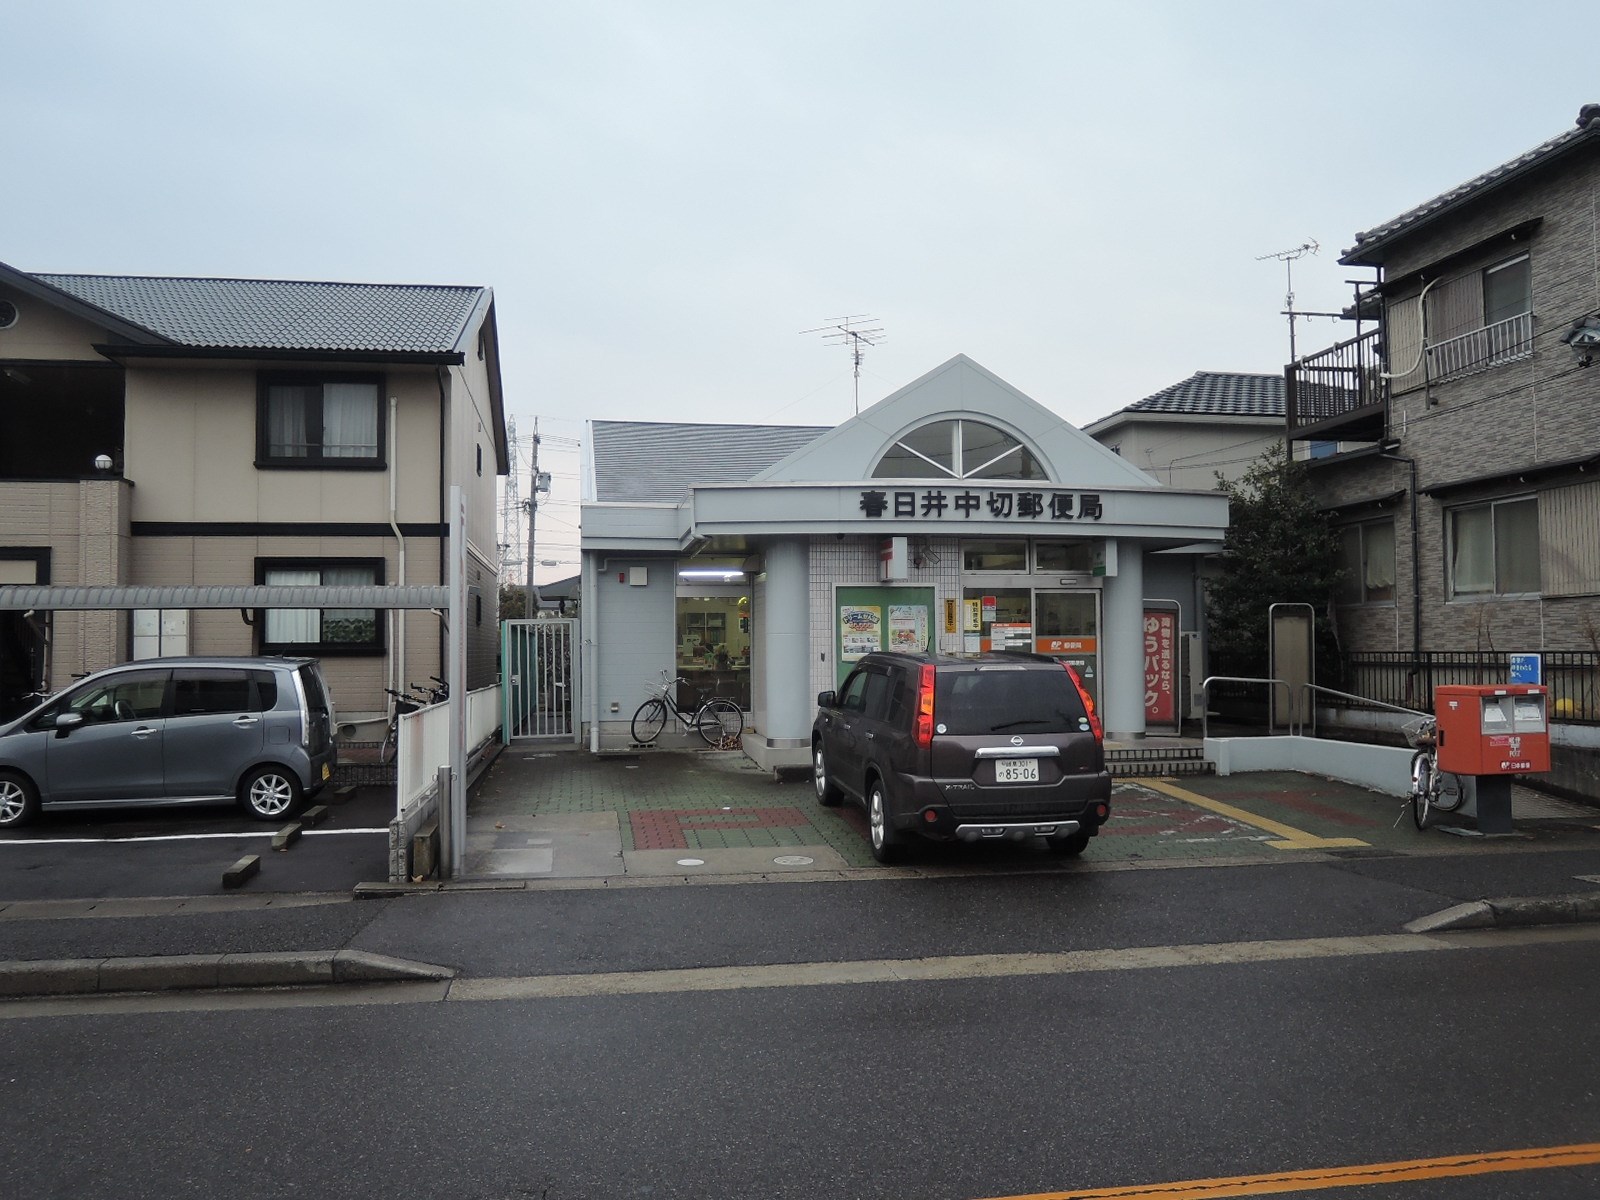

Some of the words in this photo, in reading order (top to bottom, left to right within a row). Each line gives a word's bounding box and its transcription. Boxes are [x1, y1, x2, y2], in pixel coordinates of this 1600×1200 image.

[860, 490, 1103, 520] 春日井中切郵便局
[1143, 617, 1160, 714] ゆうパック。
[1005, 768, 1037, 780] 85-06
